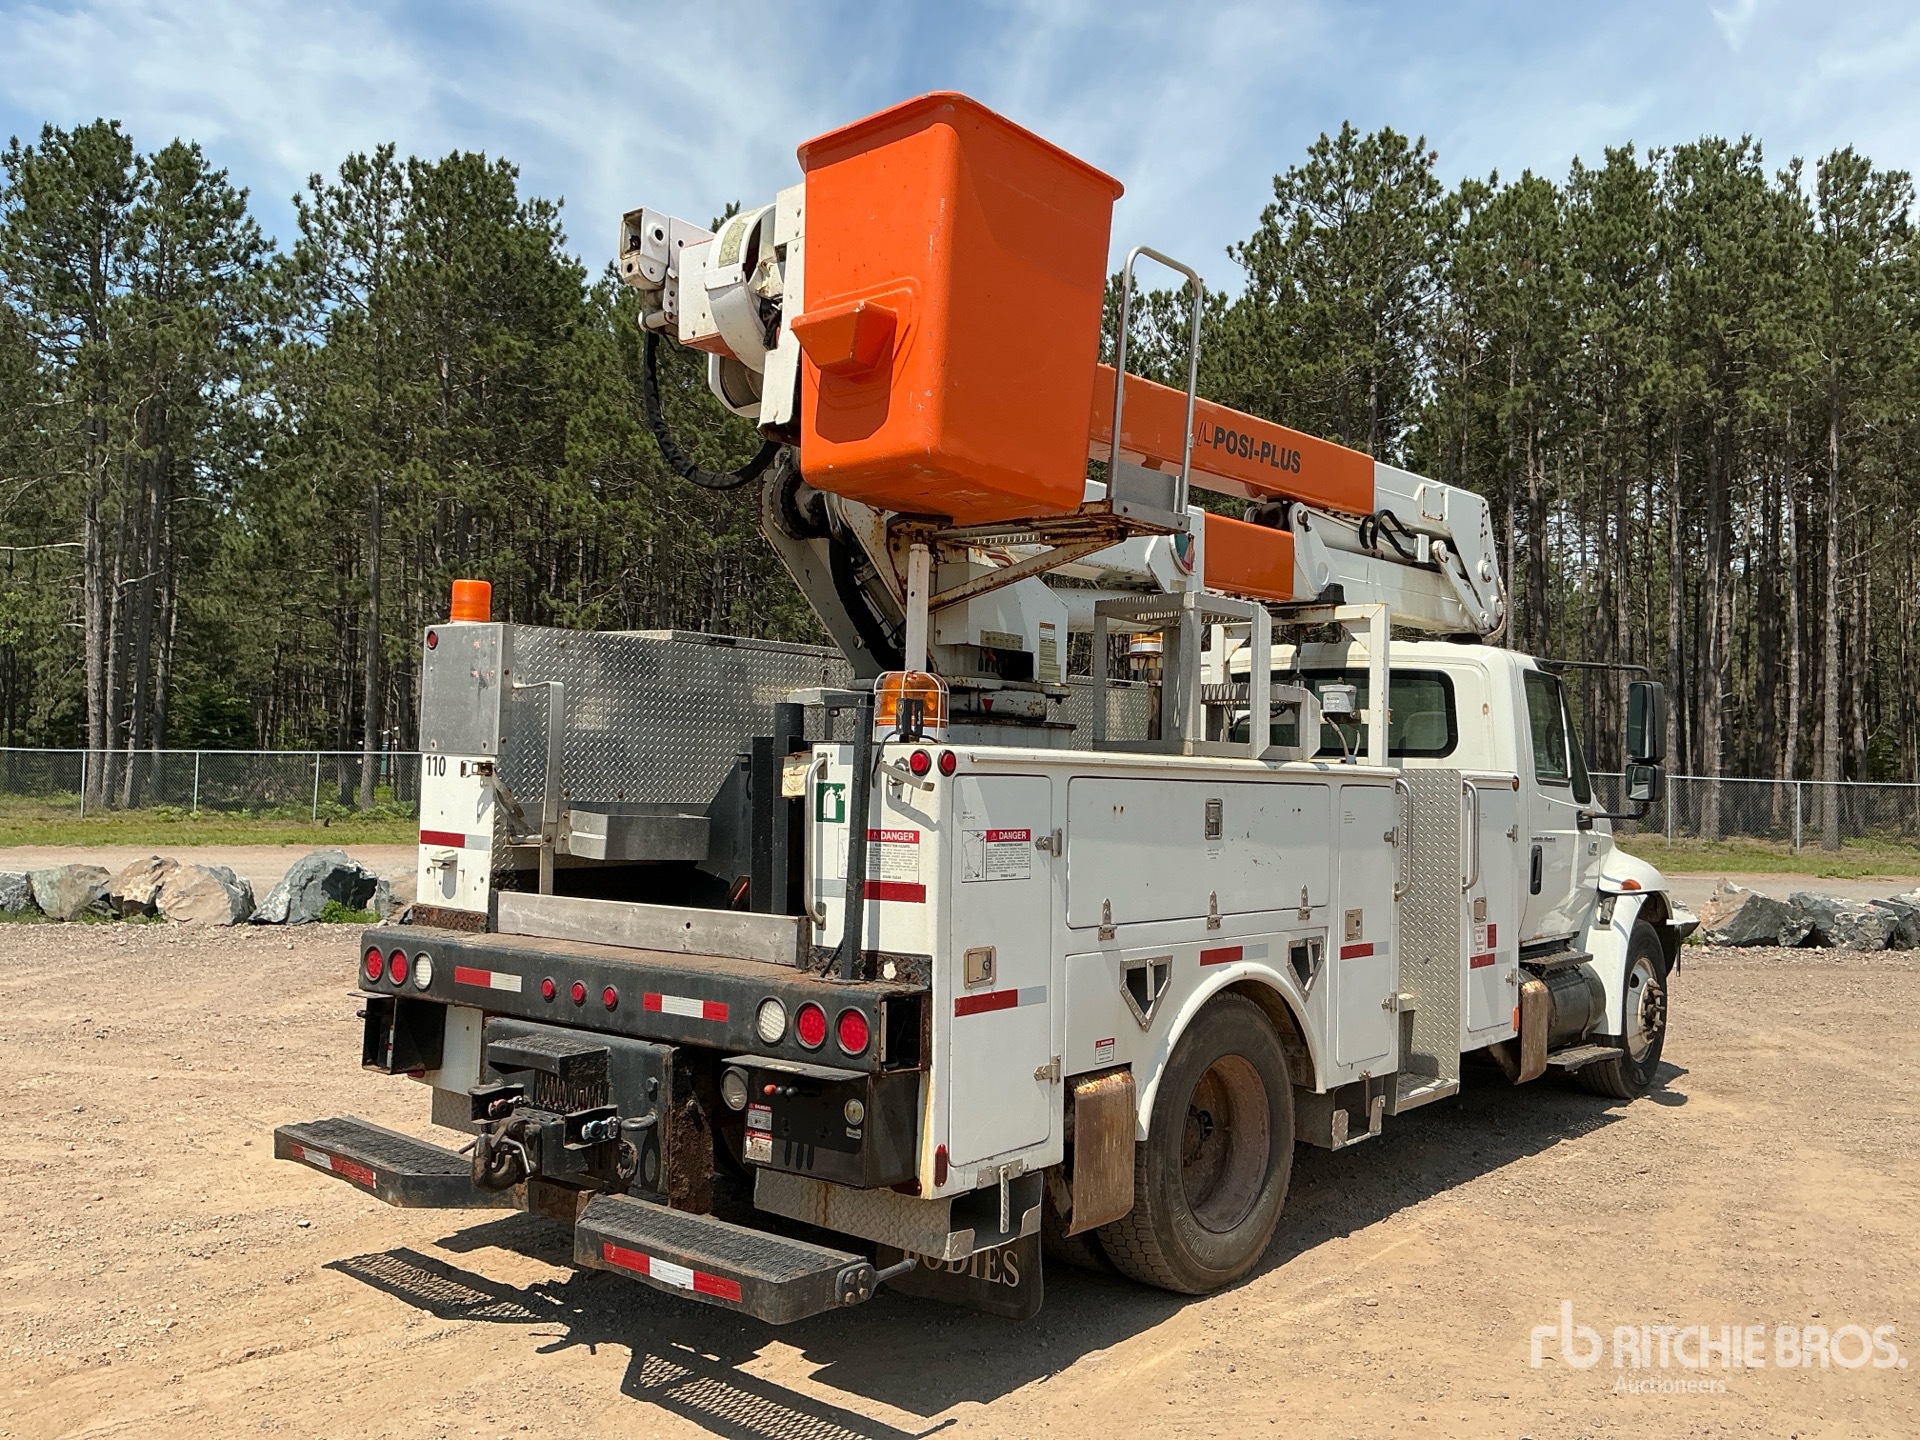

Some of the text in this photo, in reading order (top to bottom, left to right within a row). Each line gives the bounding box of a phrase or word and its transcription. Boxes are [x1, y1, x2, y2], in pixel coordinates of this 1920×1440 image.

[1213, 426, 1301, 473] POSI-PLUS
[426, 755, 446, 777] 110
[880, 831, 914, 841] DANGER
[998, 831, 1027, 840] DANGER
